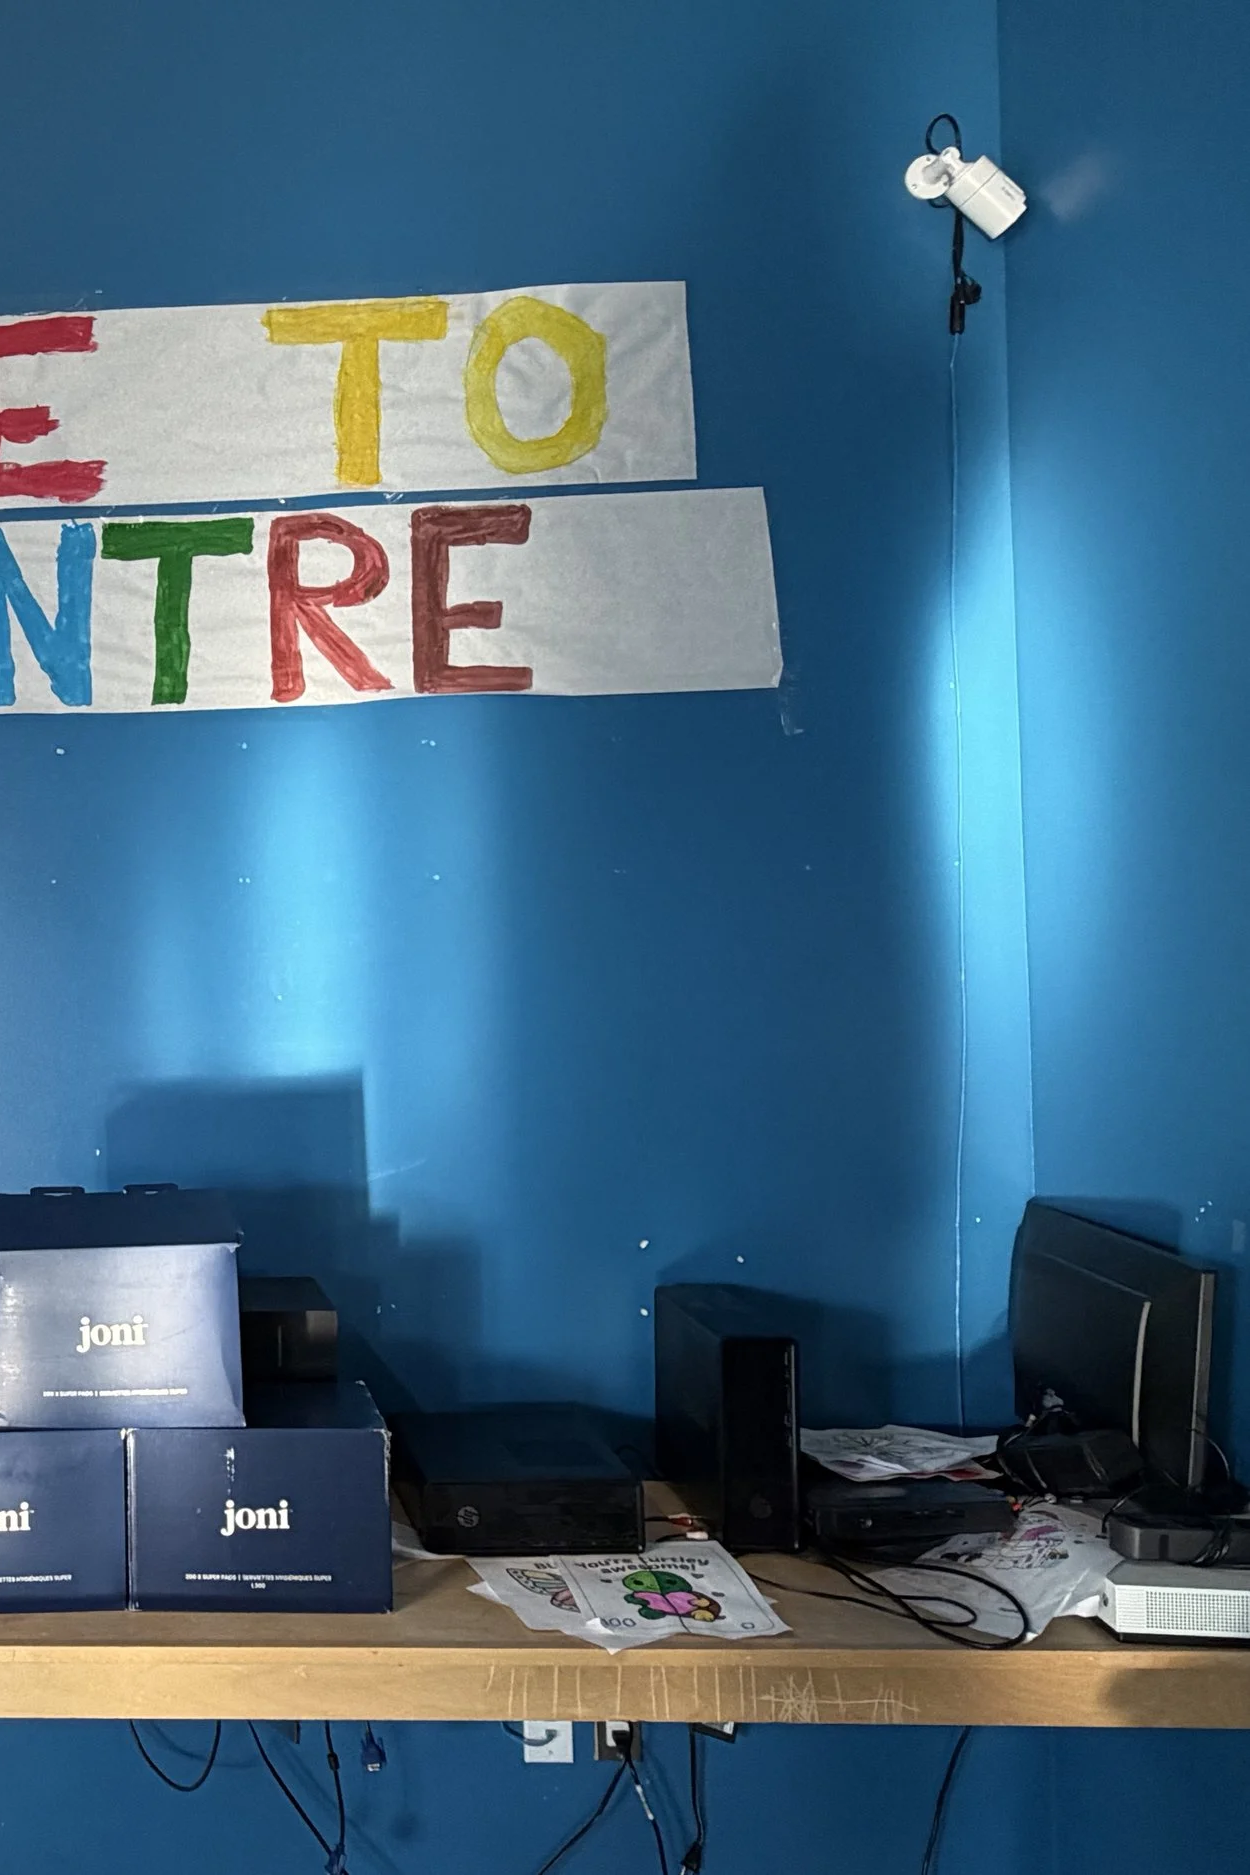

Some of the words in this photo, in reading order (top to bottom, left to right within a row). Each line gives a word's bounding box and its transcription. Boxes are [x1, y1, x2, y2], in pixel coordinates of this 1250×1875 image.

[261, 293, 608, 487] TO
[75, 1315, 146, 1353] joni
[220, 1499, 291, 1537] joni
[600, 1563, 697, 1575] awesome!
